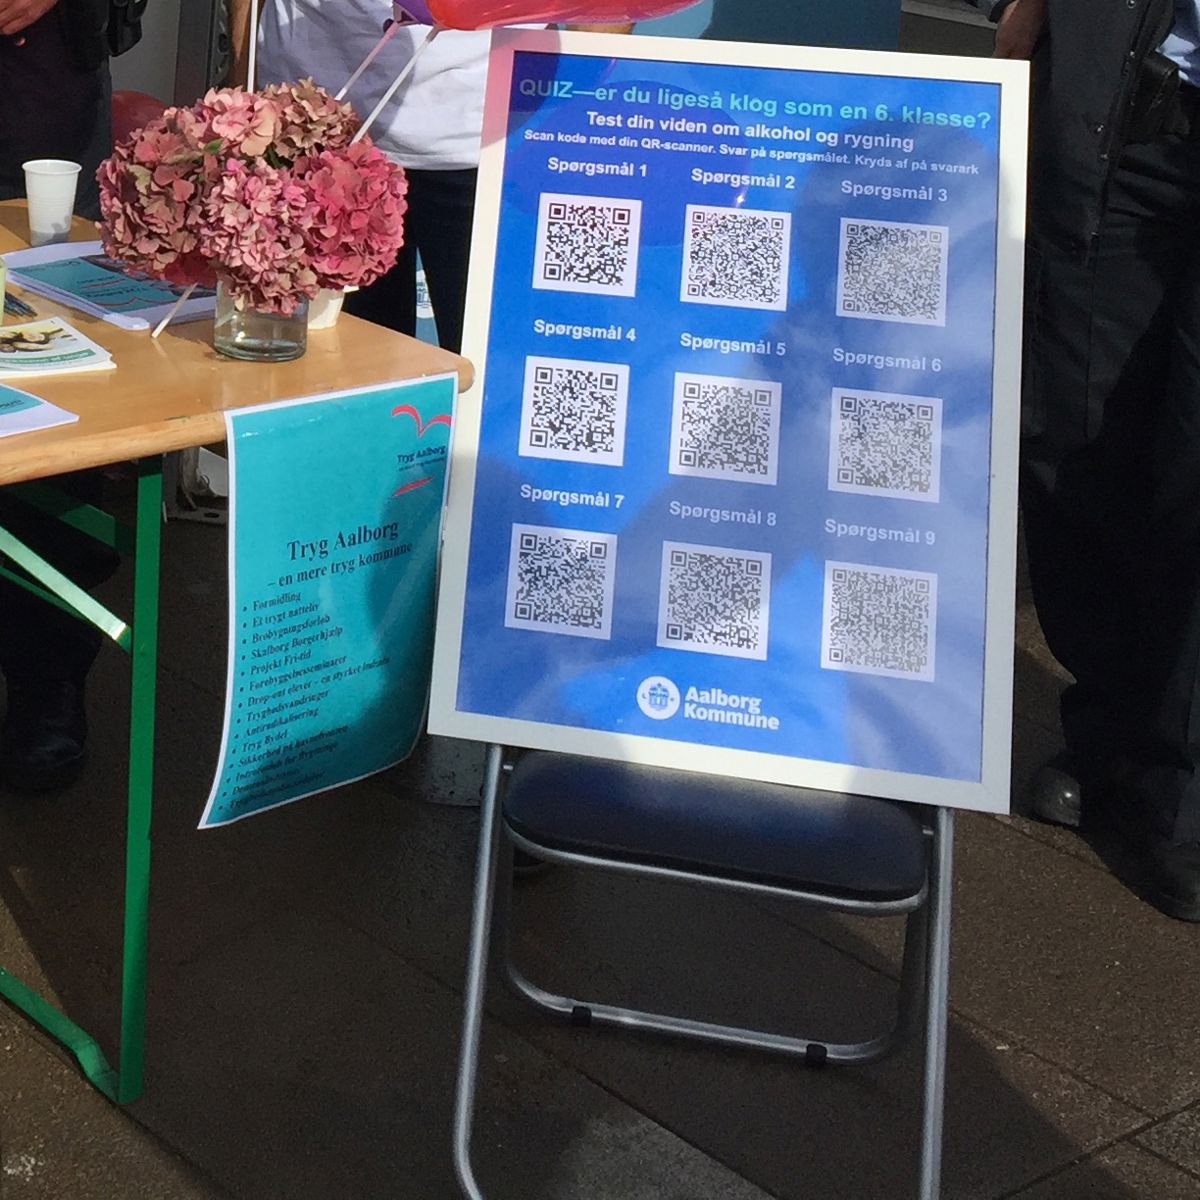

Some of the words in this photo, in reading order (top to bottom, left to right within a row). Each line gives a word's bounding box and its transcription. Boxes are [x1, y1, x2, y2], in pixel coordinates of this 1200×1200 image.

[623, 87, 650, 104] du
[658, 88, 723, 110] ligeså
[730, 93, 777, 117] klog
[785, 101, 832, 117] som
[840, 105, 867, 120] en
[875, 105, 894, 121] 6.
[902, 106, 991, 129] klasse?
[587, 112, 622, 127] Test
[627, 115, 654, 129] din
[660, 118, 707, 133] viden
[712, 123, 739, 136] om
[745, 124, 810, 141] alkohol
[816, 130, 839, 146] og
[844, 133, 914, 152] rygning
[524, 130, 554, 142] Scan
[557, 132, 586, 144] kode
[589, 135, 616, 146] med
[619, 136, 638, 148] din
[641, 138, 716, 154] QR-scanner.
[719, 144, 747, 156] Svar
[751, 148, 767, 161] på
[769, 149, 851, 165] spørgsmålet.
[855, 154, 892, 169] Kryds
[896, 158, 908, 169] af
[912, 160, 927, 173] på
[931, 163, 979, 176] svarark
[548, 157, 634, 177] Spørgsmål
[639, 164, 648, 177] 1
[691, 168, 780, 188] Spørgsmål
[785, 176, 795, 189] 2
[841, 180, 932, 201] Spørgsmål
[938, 188, 948, 201] 3
[533, 318, 622, 341] Spørgsmål
[626, 328, 637, 342] 4
[680, 332, 770, 355] Spørgsmål
[776, 342, 787, 356] 5
[833, 347, 927, 371] Spørgsmål
[931, 358, 942, 372] 6
[520, 483, 610, 508] Spørgsmål
[614, 494, 624, 508] 7
[669, 500, 762, 525] Spørgsmål
[766, 511, 777, 526] 8
[287, 538, 329, 562] Tryg
[333, 521, 399, 551] Aalborg
[825, 518, 919, 544] Spørgsmål
[925, 530, 936, 545] 9
[278, 575, 293, 587] en
[296, 565, 327, 584] mere
[331, 558, 355, 576] tryg
[358, 542, 413, 568] kommune
[250, 660, 282, 676] Projekt
[685, 686, 761, 714] Aalborg
[684, 703, 780, 730] Kommune
